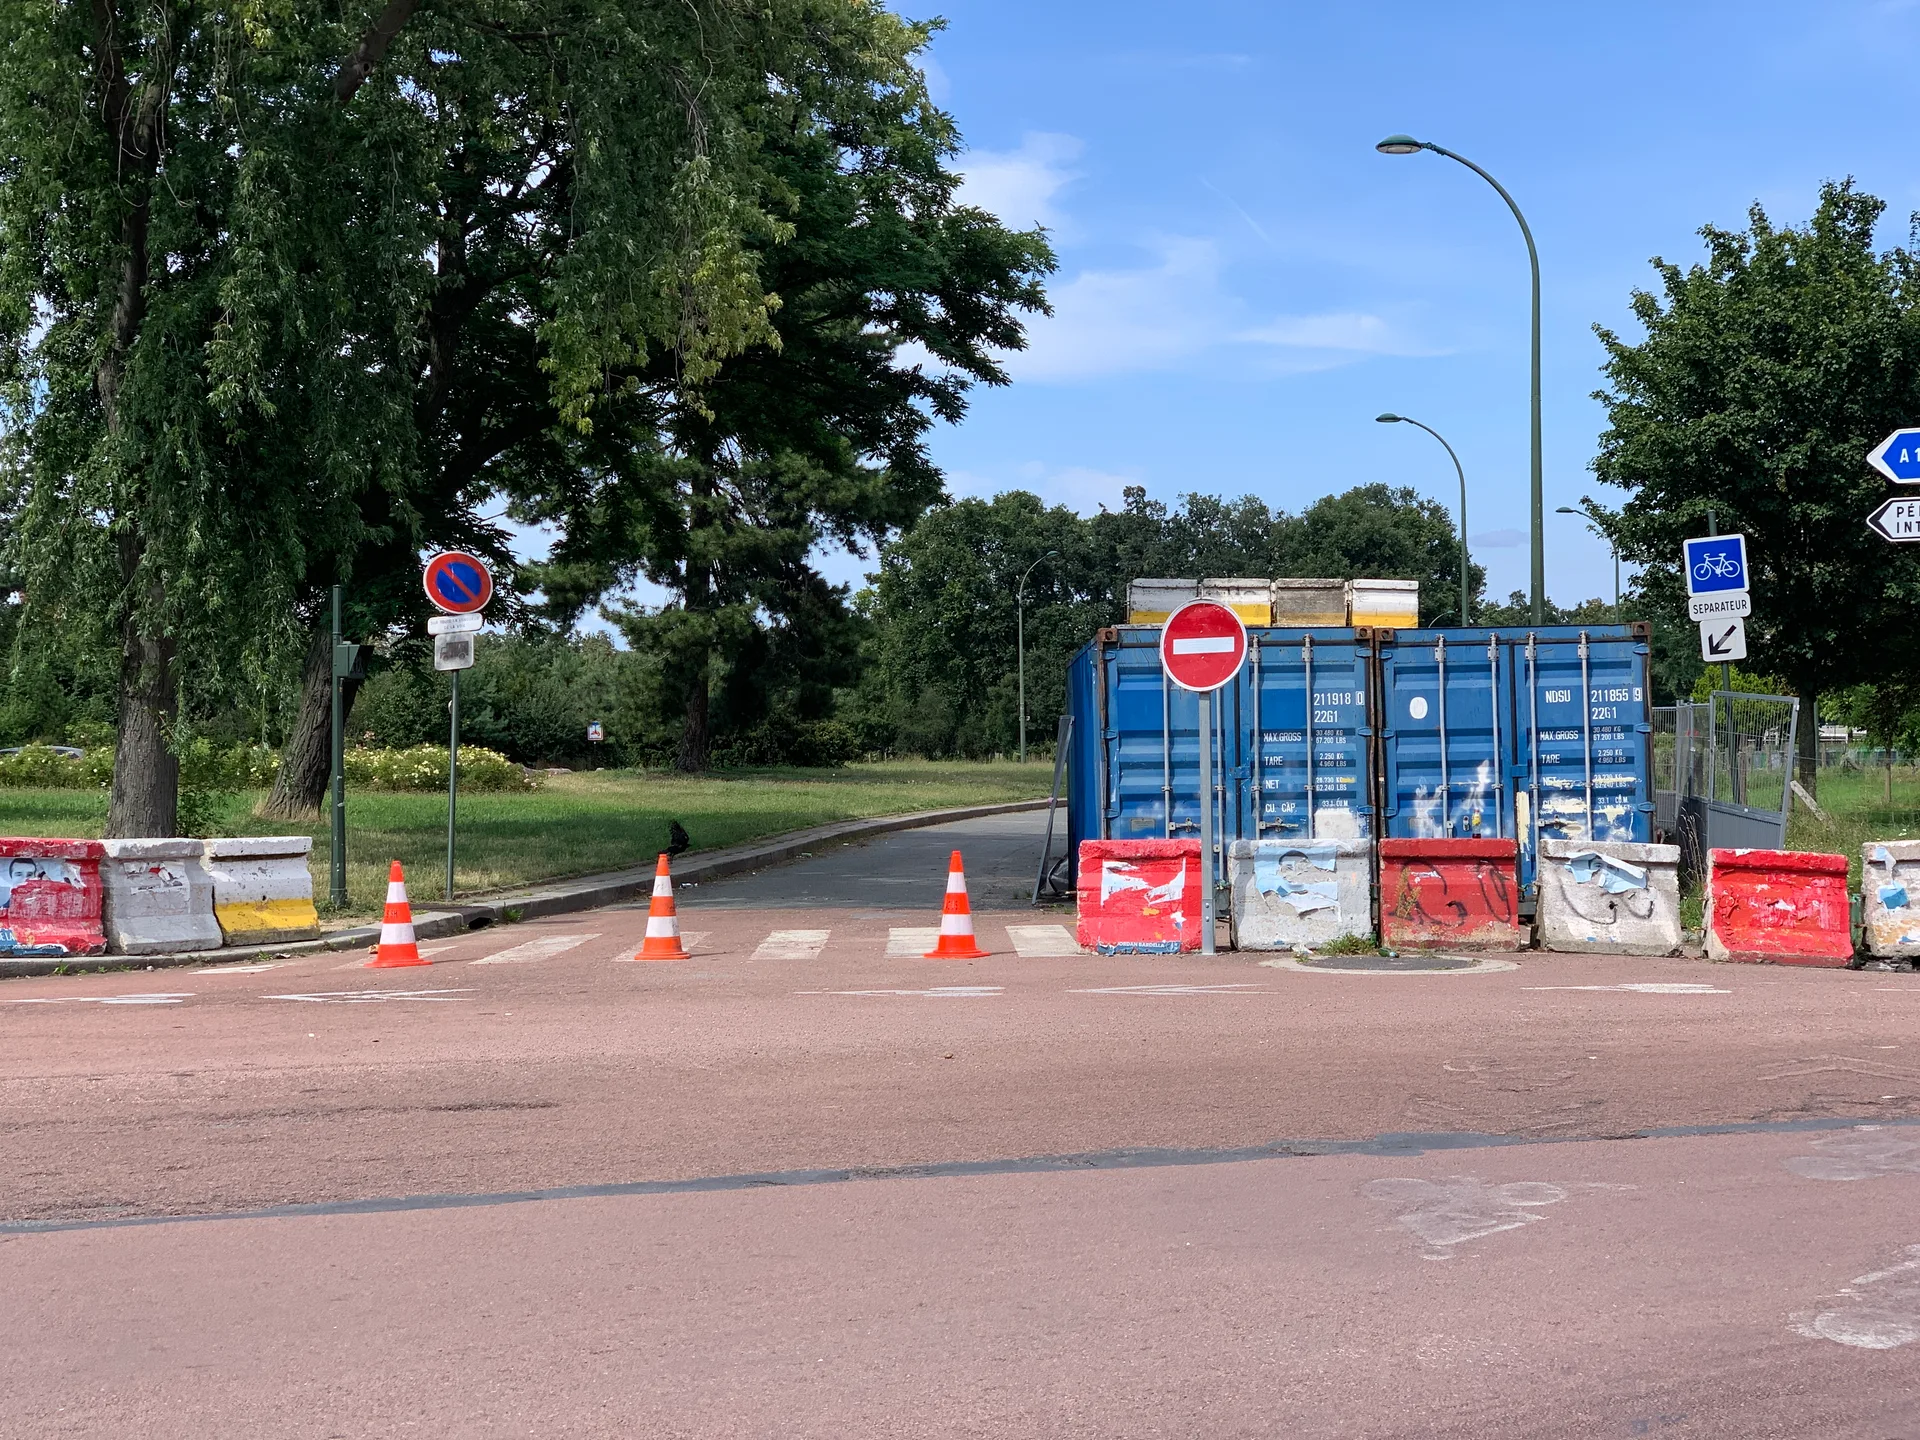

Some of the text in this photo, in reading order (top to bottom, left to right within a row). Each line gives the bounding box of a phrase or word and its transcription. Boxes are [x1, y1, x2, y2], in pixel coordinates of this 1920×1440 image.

[1897, 503, 1920, 518] PÉ
[1693, 600, 1748, 615] SEPARATEUR
[1313, 693, 1351, 706] 211918
[1545, 687, 1642, 704] NDSU 211855 9
[1314, 710, 1338, 723] 22G1
[1592, 707, 1617, 720] 22G1
[1539, 730, 1579, 741] MAX.GROSS
[1264, 756, 1284, 766] TARE
[1541, 754, 1561, 764] TARE
[1265, 779, 1280, 790] NET
